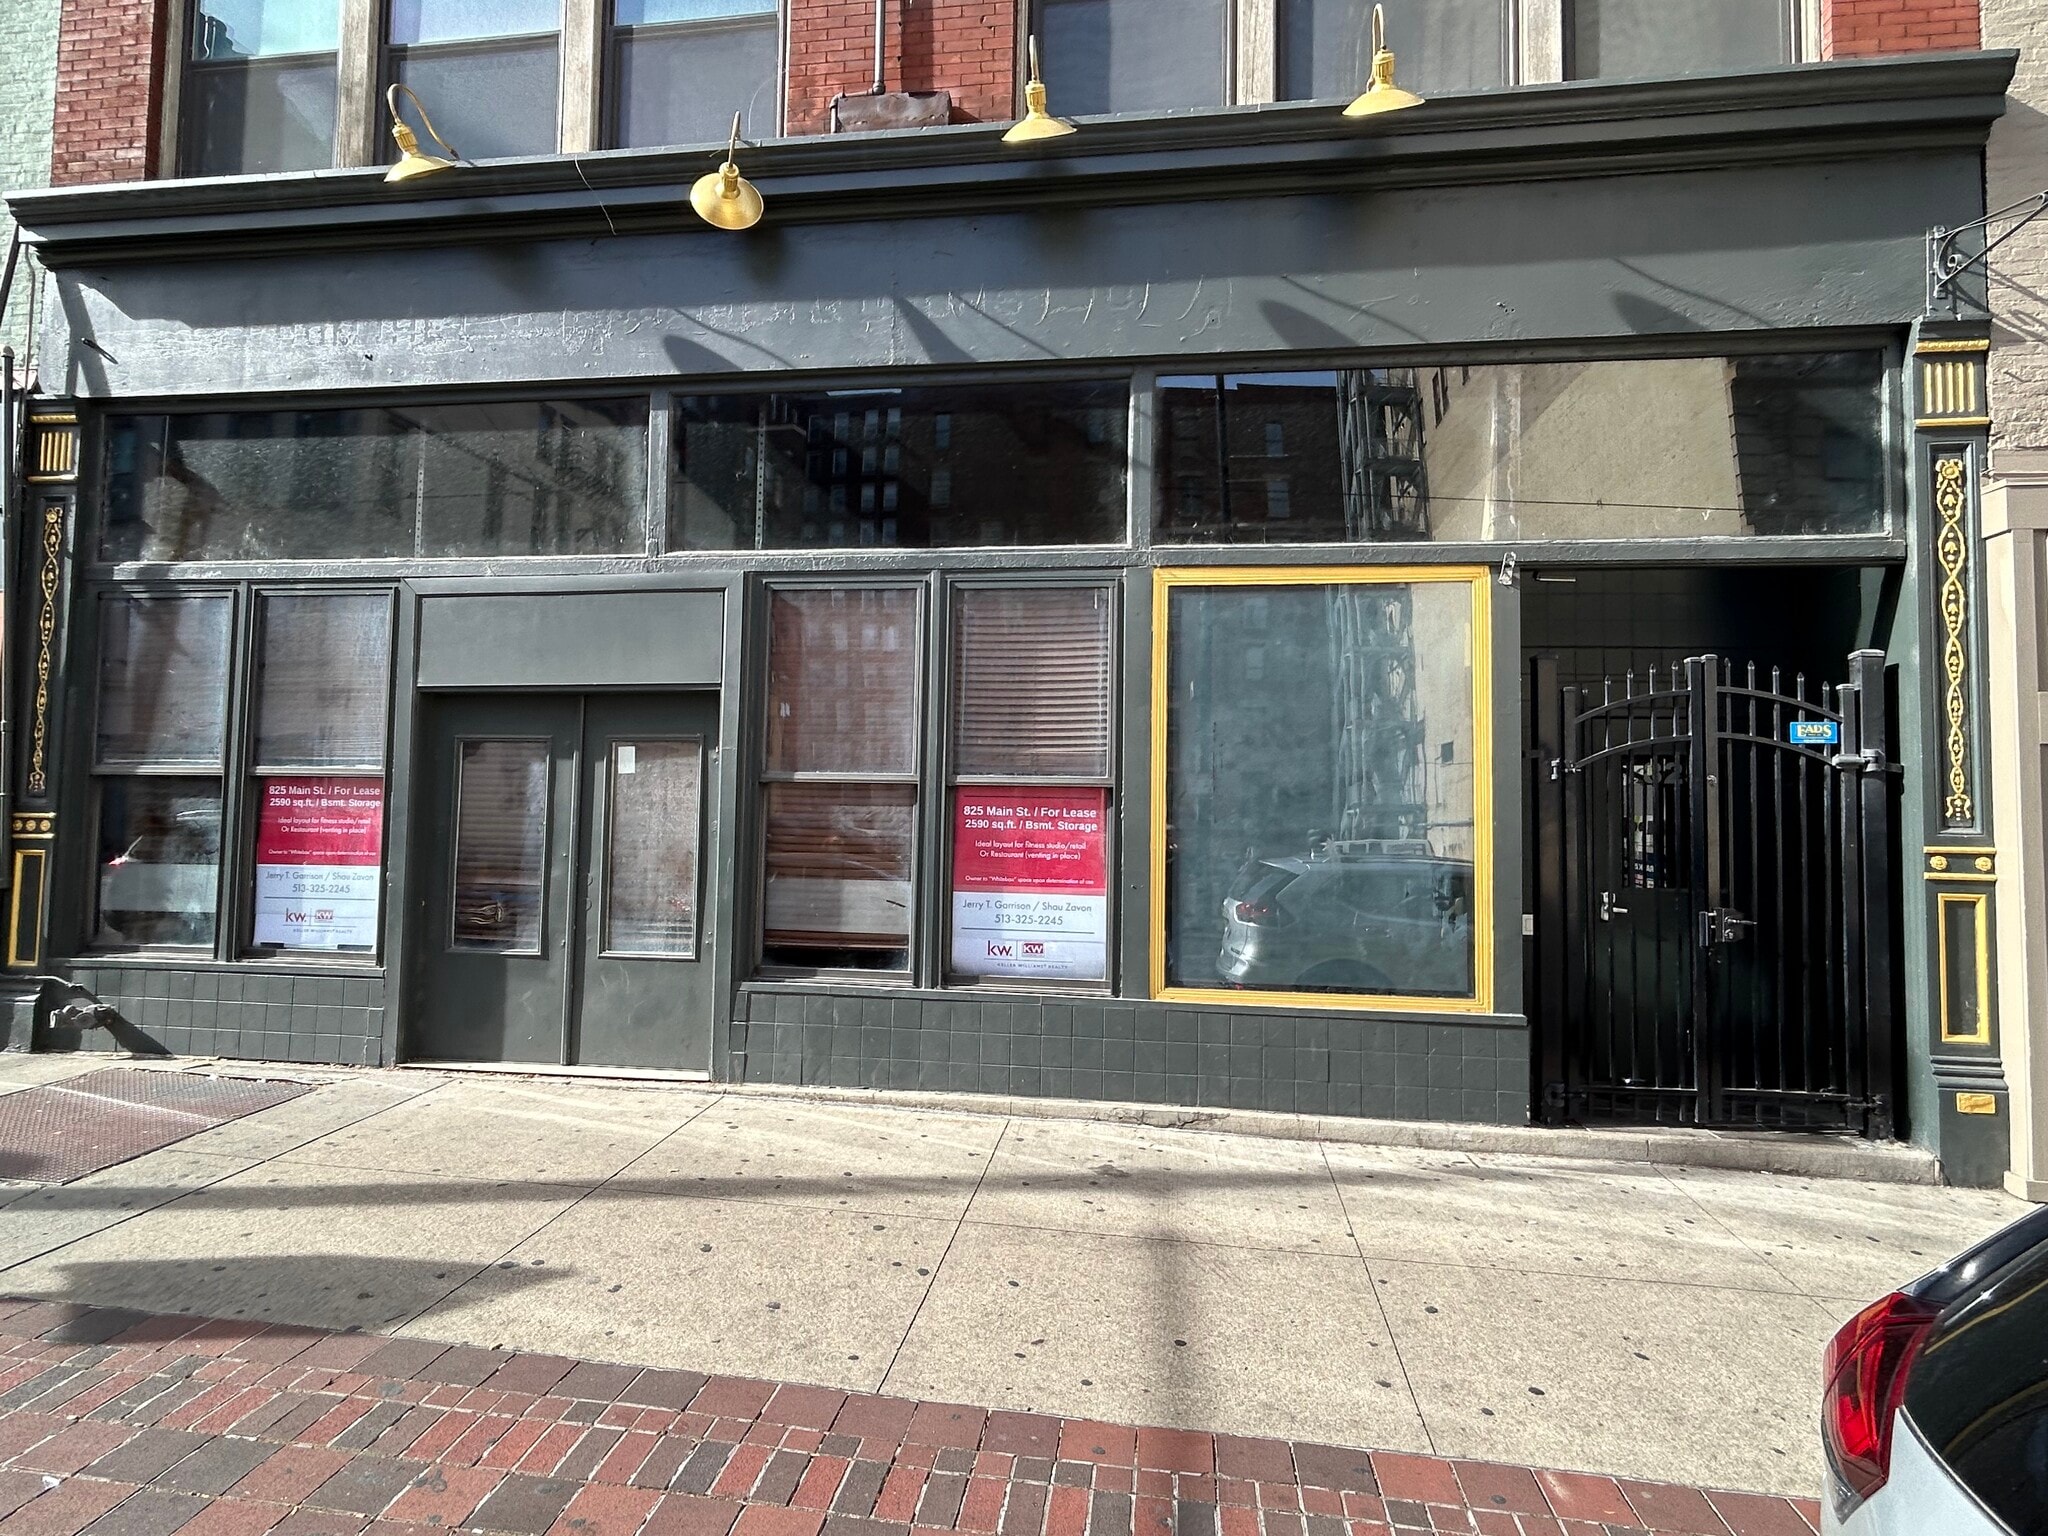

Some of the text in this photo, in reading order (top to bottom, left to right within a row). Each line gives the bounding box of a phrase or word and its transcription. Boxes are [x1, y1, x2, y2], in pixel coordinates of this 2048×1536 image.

[1797, 724, 1832, 737] EADS
[269, 786, 286, 795] 825
[288, 786, 310, 795] Main
[313, 786, 326, 795] St.
[334, 786, 351, 795] For
[353, 787, 380, 796] Lease
[269, 798, 291, 807] 2590
[292, 798, 314, 809] sq.ft.
[321, 799, 347, 807] Bsmt.
[348, 799, 381, 809] Storage
[963, 806, 1097, 818] 825 Main St. / For Lease
[278, 816, 292, 824] Ideal
[293, 816, 311, 825] layout
[965, 819, 1097, 833] 2590 sq.ft. / Bsmt. Storage
[993, 840, 1013, 849] layout
[1025, 841, 1045, 849] fitness
[1046, 841, 1086, 850] studio/retail
[991, 850, 1024, 858] Restaurant
[1025, 850, 1051, 860] (venting
[1059, 852, 1081, 860] place)
[266, 871, 284, 880] Jerry
[292, 872, 323, 880] Garrison
[324, 872, 330, 881] /
[332, 872, 350, 880] Shau
[352, 872, 374, 880] Zavon
[292, 884, 350, 893] 513-325-2245
[962, 899, 1092, 912] Jerry T. Garrison / Shau Zavon
[316, 911, 333, 919] KW
[994, 914, 1063, 925] 513-325-2245
[1023, 945, 1043, 953] KW
